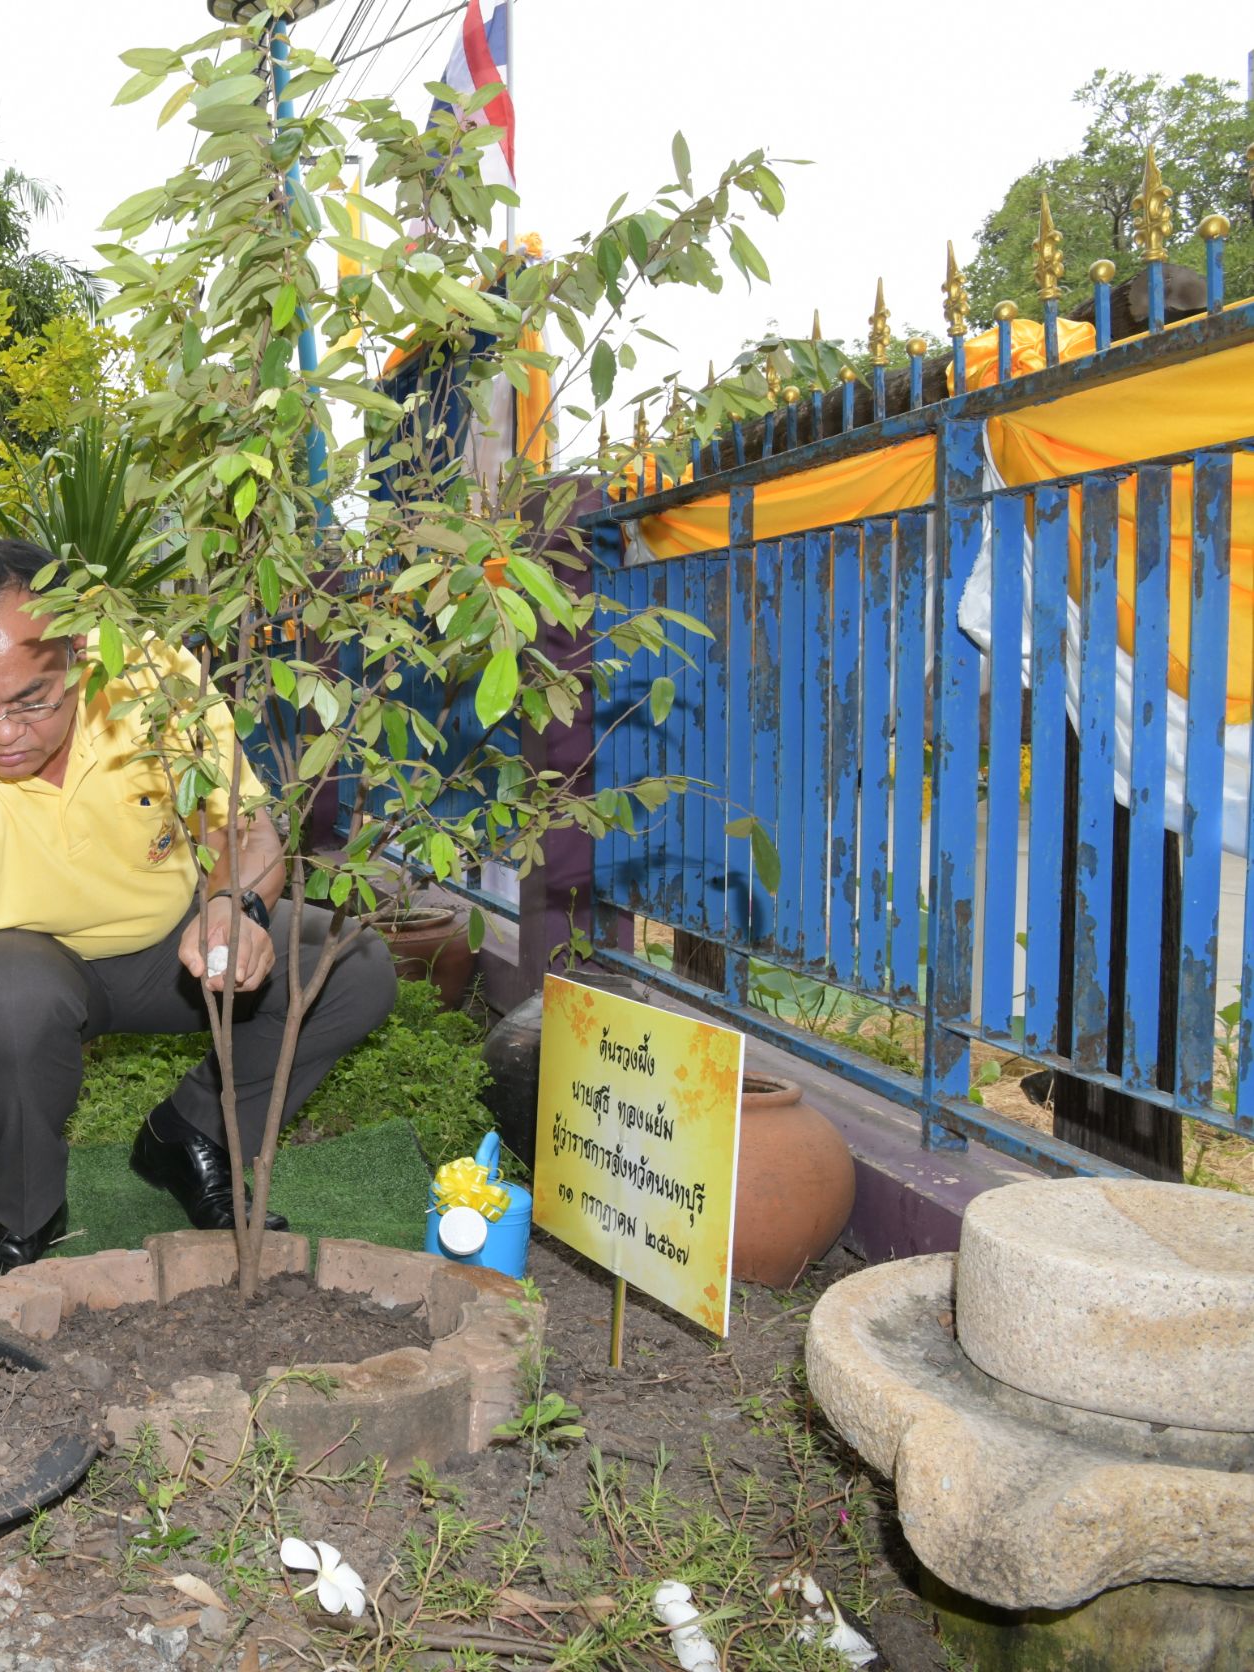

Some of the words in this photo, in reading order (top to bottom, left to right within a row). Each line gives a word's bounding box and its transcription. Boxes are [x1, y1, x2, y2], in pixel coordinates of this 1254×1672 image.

[572, 1080, 610, 1126] นายสุธี
[618, 1100, 674, 1142] ทองแย้ม
[553, 1112, 706, 1228] ผู้ว่าราชการจังหวัดนนทบุรี
[558, 1183, 574, 1203] ๓๑
[581, 1191, 637, 1238] กรกฎาคม
[645, 1221, 690, 1266] ๒๕๖๗
